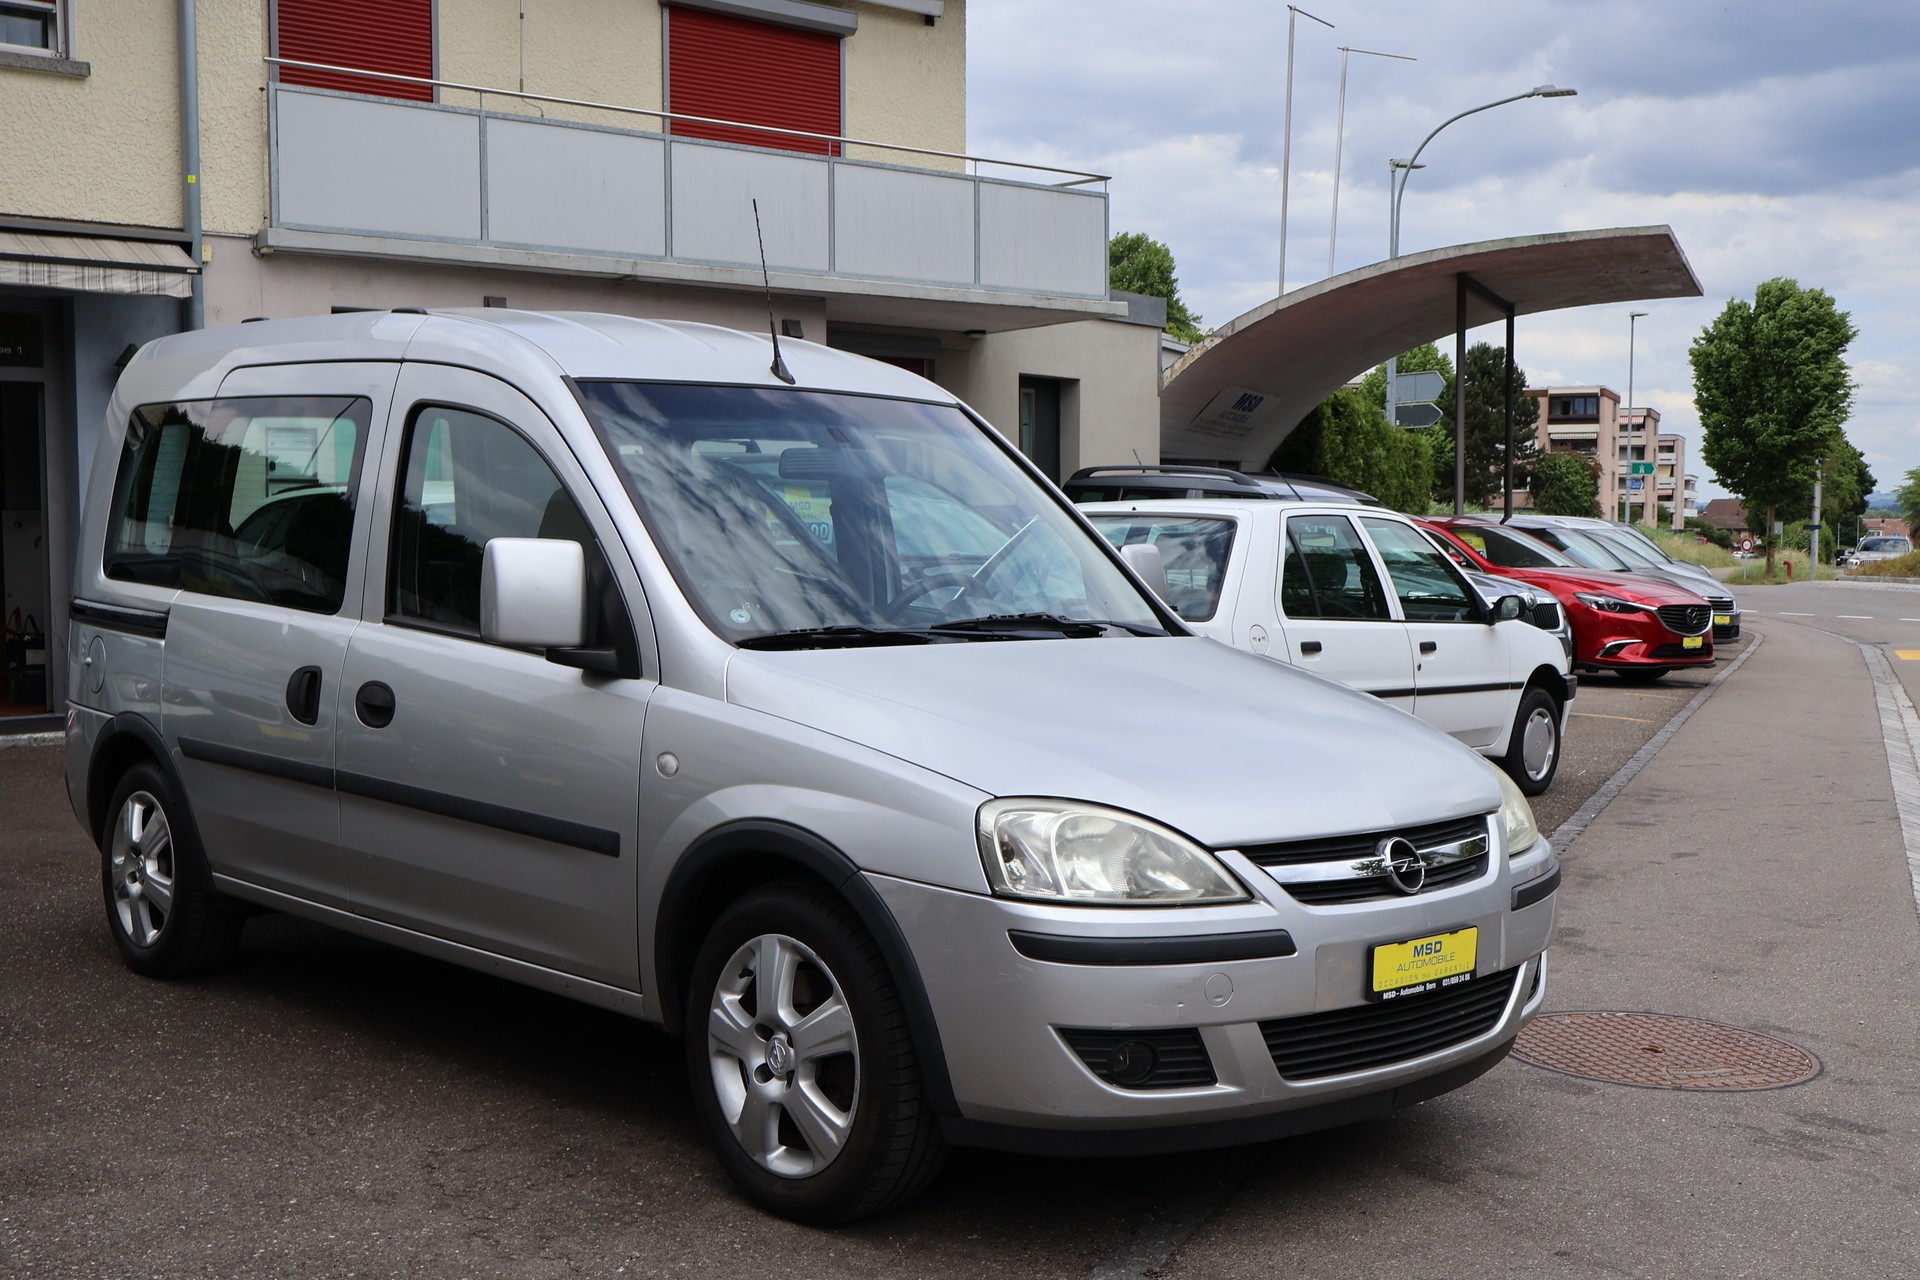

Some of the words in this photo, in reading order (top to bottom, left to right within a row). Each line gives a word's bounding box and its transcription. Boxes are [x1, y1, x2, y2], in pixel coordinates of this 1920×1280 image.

[1231, 392, 1264, 412] MSD
[789, 501, 811, 511] MSD
[1413, 940, 1442, 958] MSD
[1396, 952, 1456, 973] AUTOMOBILE
[1378, 973, 1419, 989] OCCASION
[1435, 962, 1470, 976] GARANTIE
[1382, 990, 1396, 1000] MSD
[1400, 984, 1425, 996] Automobile
[1426, 982, 1437, 991] Bern
